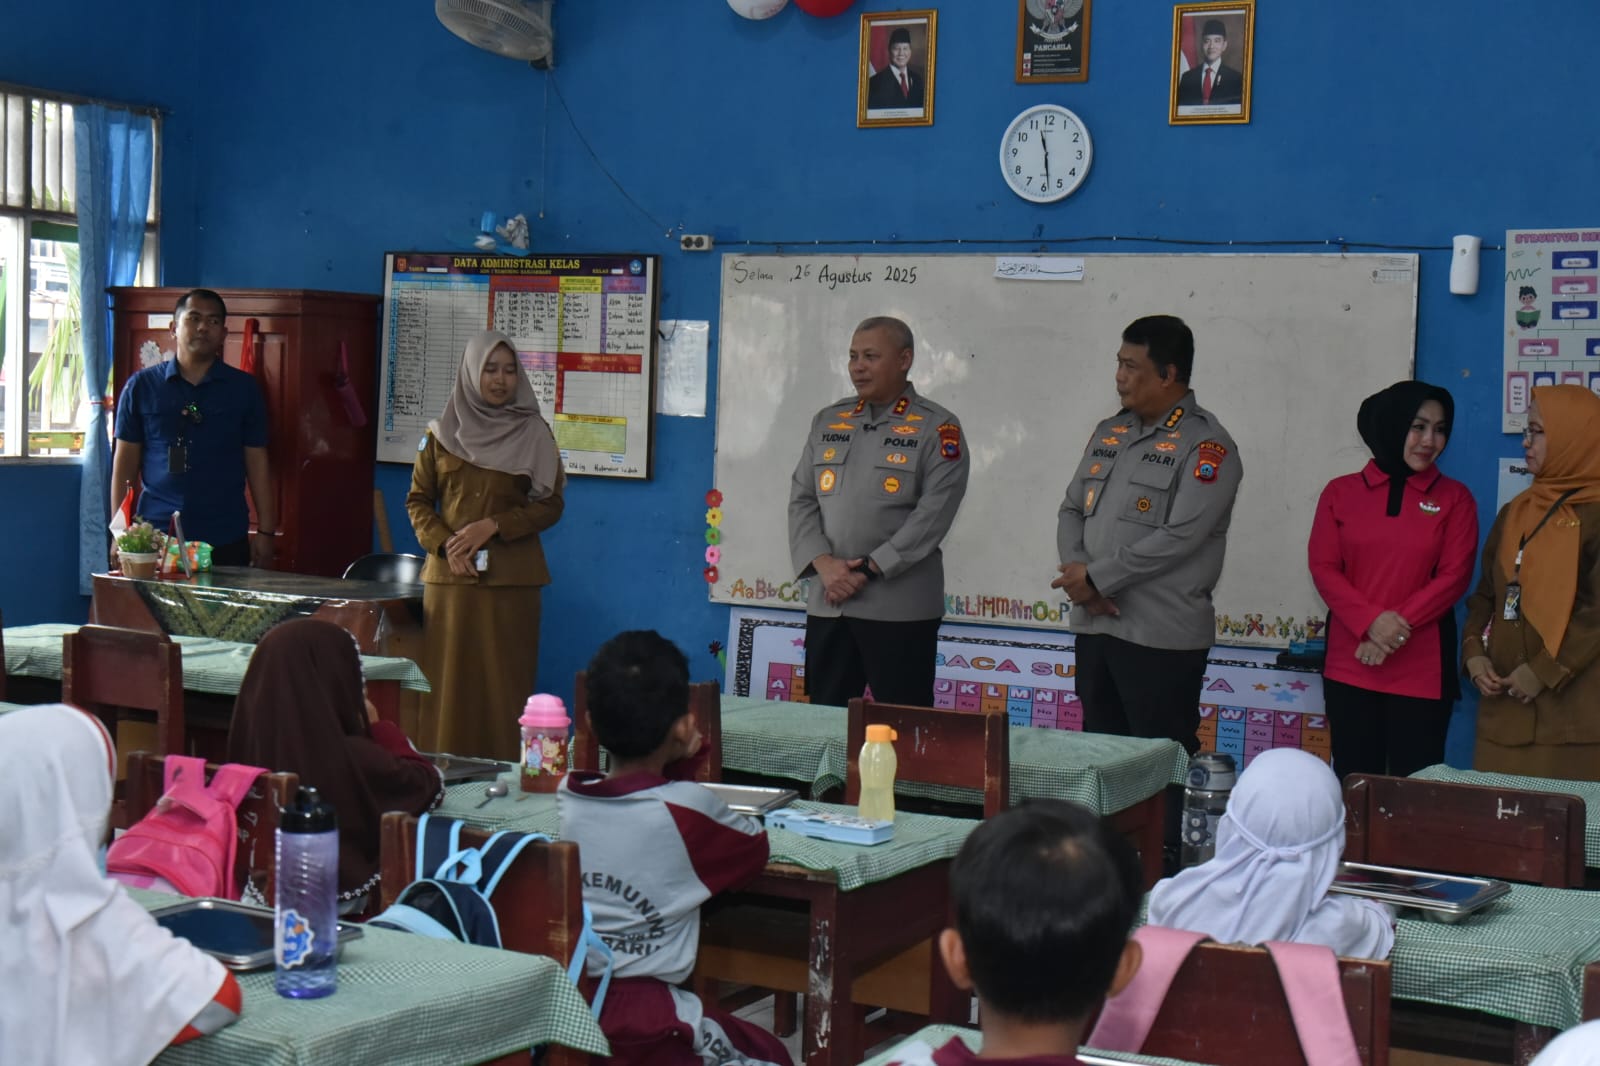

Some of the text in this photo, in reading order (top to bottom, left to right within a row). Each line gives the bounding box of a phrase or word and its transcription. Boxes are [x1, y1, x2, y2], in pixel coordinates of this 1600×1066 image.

[1030, 120, 1039, 130] 11
[1045, 115, 1055, 125] 12
[1063, 120, 1067, 130] 1
[1018, 132, 1028, 142] 10
[1072, 133, 1079, 142] 2
[1012, 148, 1018, 157] 9
[1076, 150, 1083, 160] 3
[1015, 165, 1021, 175] 8
[1069, 167, 1076, 177] 4
[1026, 176, 1033, 186] 7
[1056, 179, 1063, 188] 5
[1040, 182, 1047, 192] 6
[453, 258, 581, 269] DATA ADMINISTRASI KELAS
[818, 264, 873, 289] Agustus
[884, 265, 918, 284] 2025
[821, 433, 851, 443] YUDHA
[884, 437, 919, 449] POLRI
[1142, 453, 1176, 467] POLRI
[1509, 465, 1530, 475] Bag
[771, 679, 786, 689] A
[937, 681, 952, 693] J
[960, 683, 977, 695] K
[987, 685, 1001, 697] L
[1010, 688, 1030, 699] M
[1036, 690, 1055, 703] N
[1063, 692, 1080, 704] P
[1220, 708, 1243, 721] W
[1250, 711, 1268, 722] X
[1280, 714, 1297, 726] Y
[1308, 716, 1326, 728] Z
